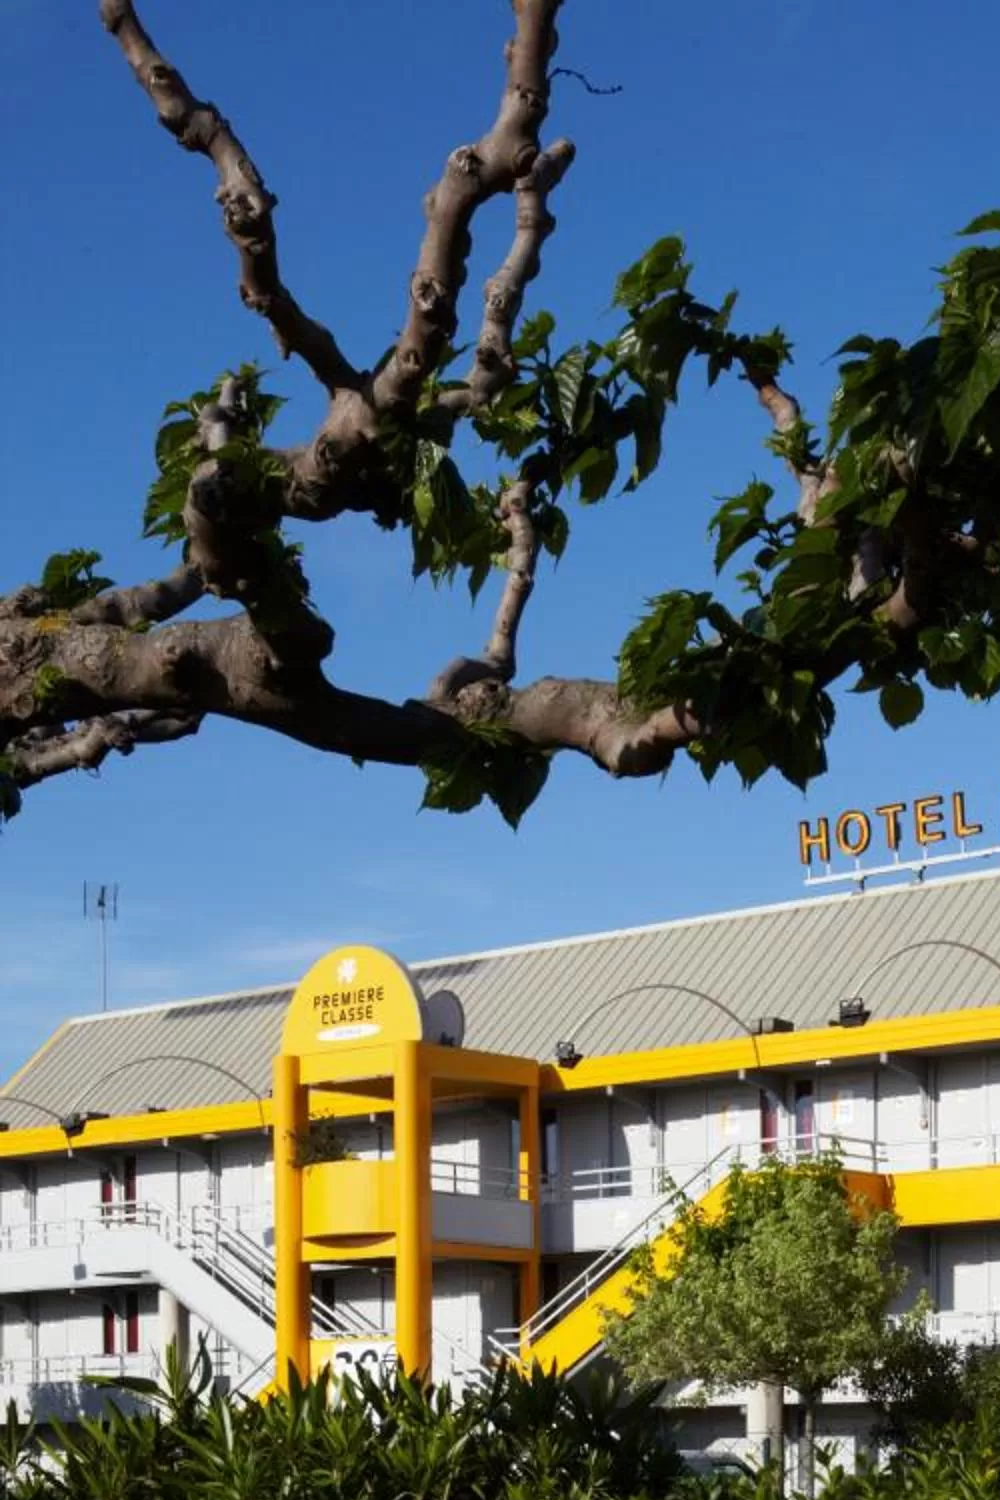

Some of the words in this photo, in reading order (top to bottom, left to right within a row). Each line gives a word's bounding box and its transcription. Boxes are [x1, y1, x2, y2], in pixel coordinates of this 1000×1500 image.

[799, 791, 983, 865] HOTEL
[313, 986, 385, 1009] PREMIERE
[321, 1005, 374, 1025] CLASSE
